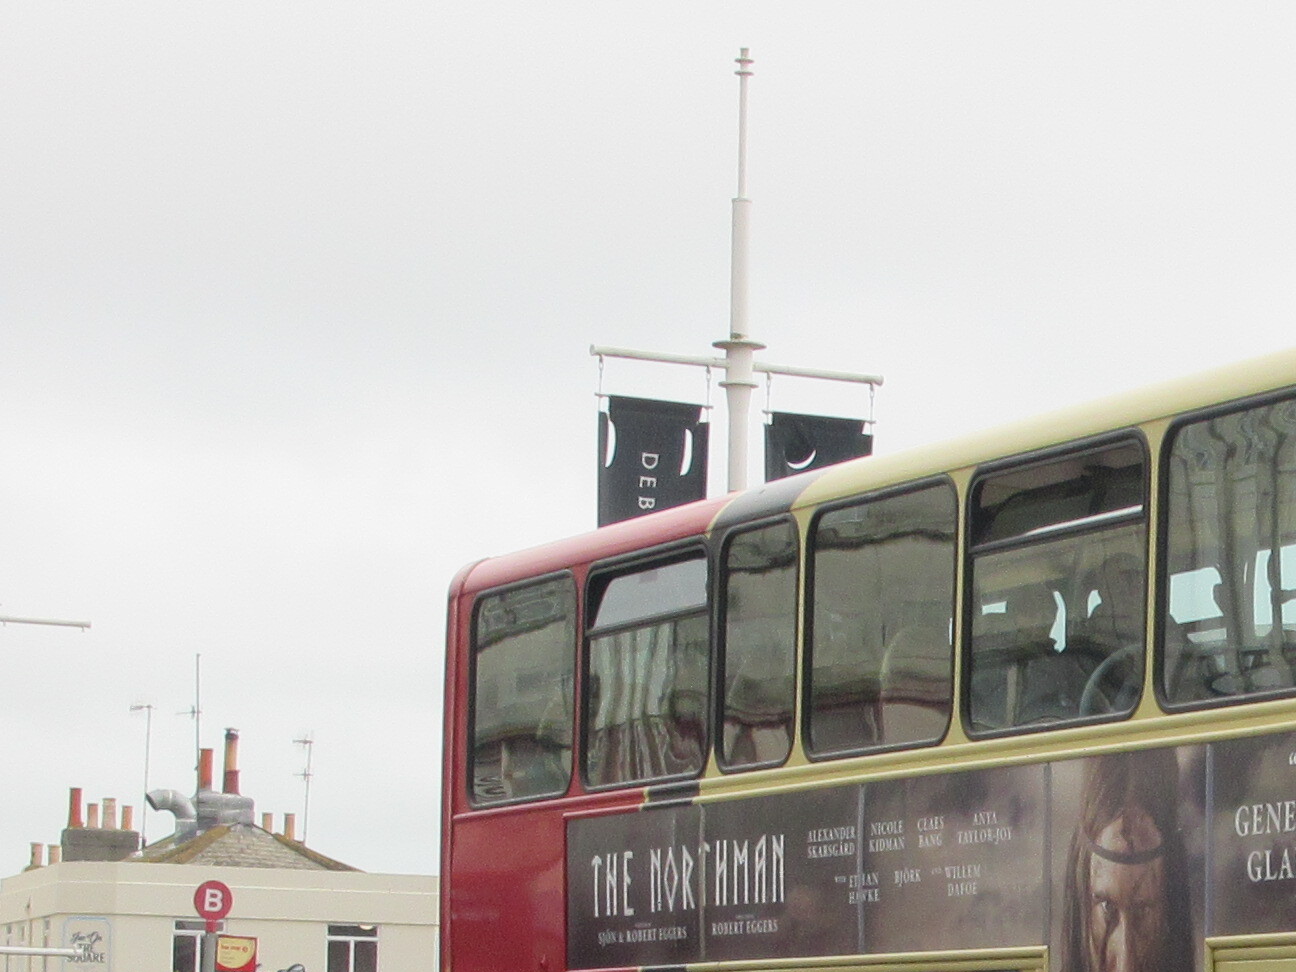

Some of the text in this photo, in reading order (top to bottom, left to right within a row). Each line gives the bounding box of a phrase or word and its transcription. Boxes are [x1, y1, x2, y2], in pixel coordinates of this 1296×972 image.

[917, 815, 945, 832] CLAES
[973, 811, 998, 826] ANYA
[807, 825, 856, 843] ALEXANDER
[870, 820, 904, 837] NICOLE
[957, 827, 1013, 845] TAYLOR-JOY
[868, 836, 905, 853] KIDMAN
[918, 833, 943, 848] BANG
[807, 841, 856, 859] SKARSGÅRD
[591, 834, 785, 918] THE NORTHMAN
[943, 863, 982, 880] WILLEM
[947, 882, 978, 897] DAFOE
[204, 888, 223, 913] B
[626, 927, 657, 943] ROBERT
[659, 926, 688, 941] EGGERS
[711, 919, 779, 936] ROBERT EGGERS
